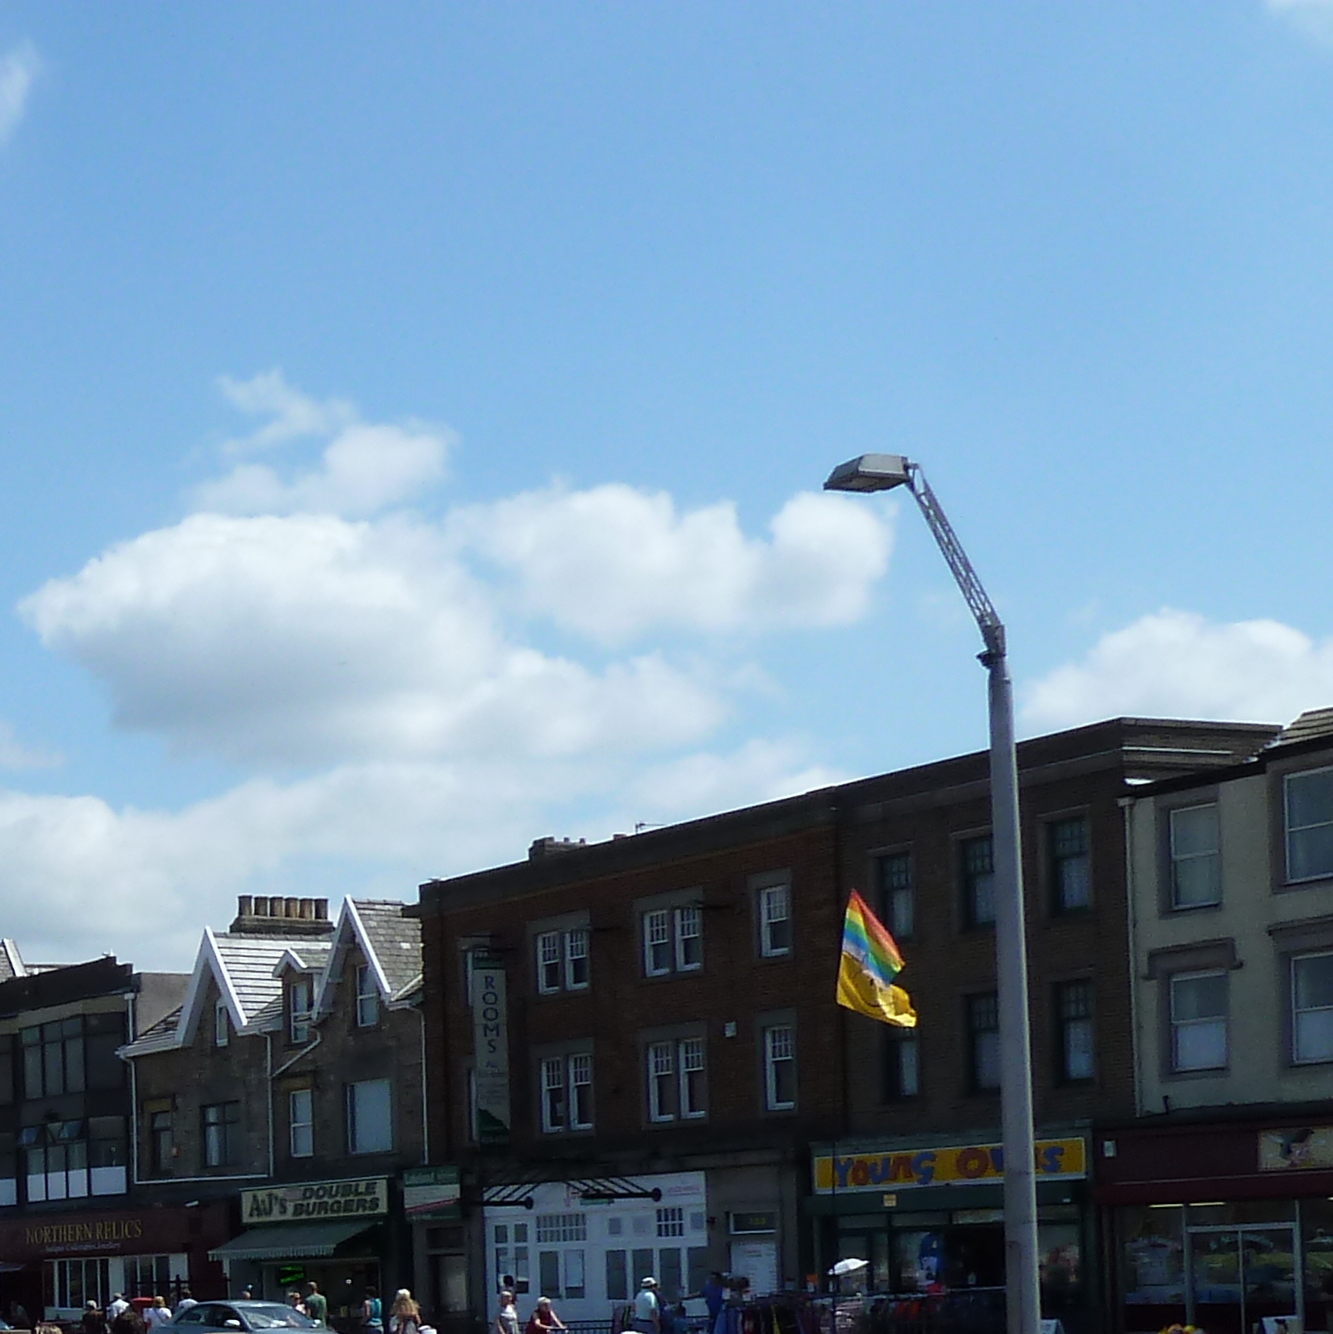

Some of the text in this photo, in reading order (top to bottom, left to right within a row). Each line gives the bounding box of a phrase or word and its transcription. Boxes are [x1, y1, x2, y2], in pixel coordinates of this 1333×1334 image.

[482, 975, 500, 1054] ROOMS
[301, 1181, 377, 1200] DOUBLE
[291, 1197, 380, 1217] BURGERS
[25, 1219, 143, 1244] NORTHERN RELICS
